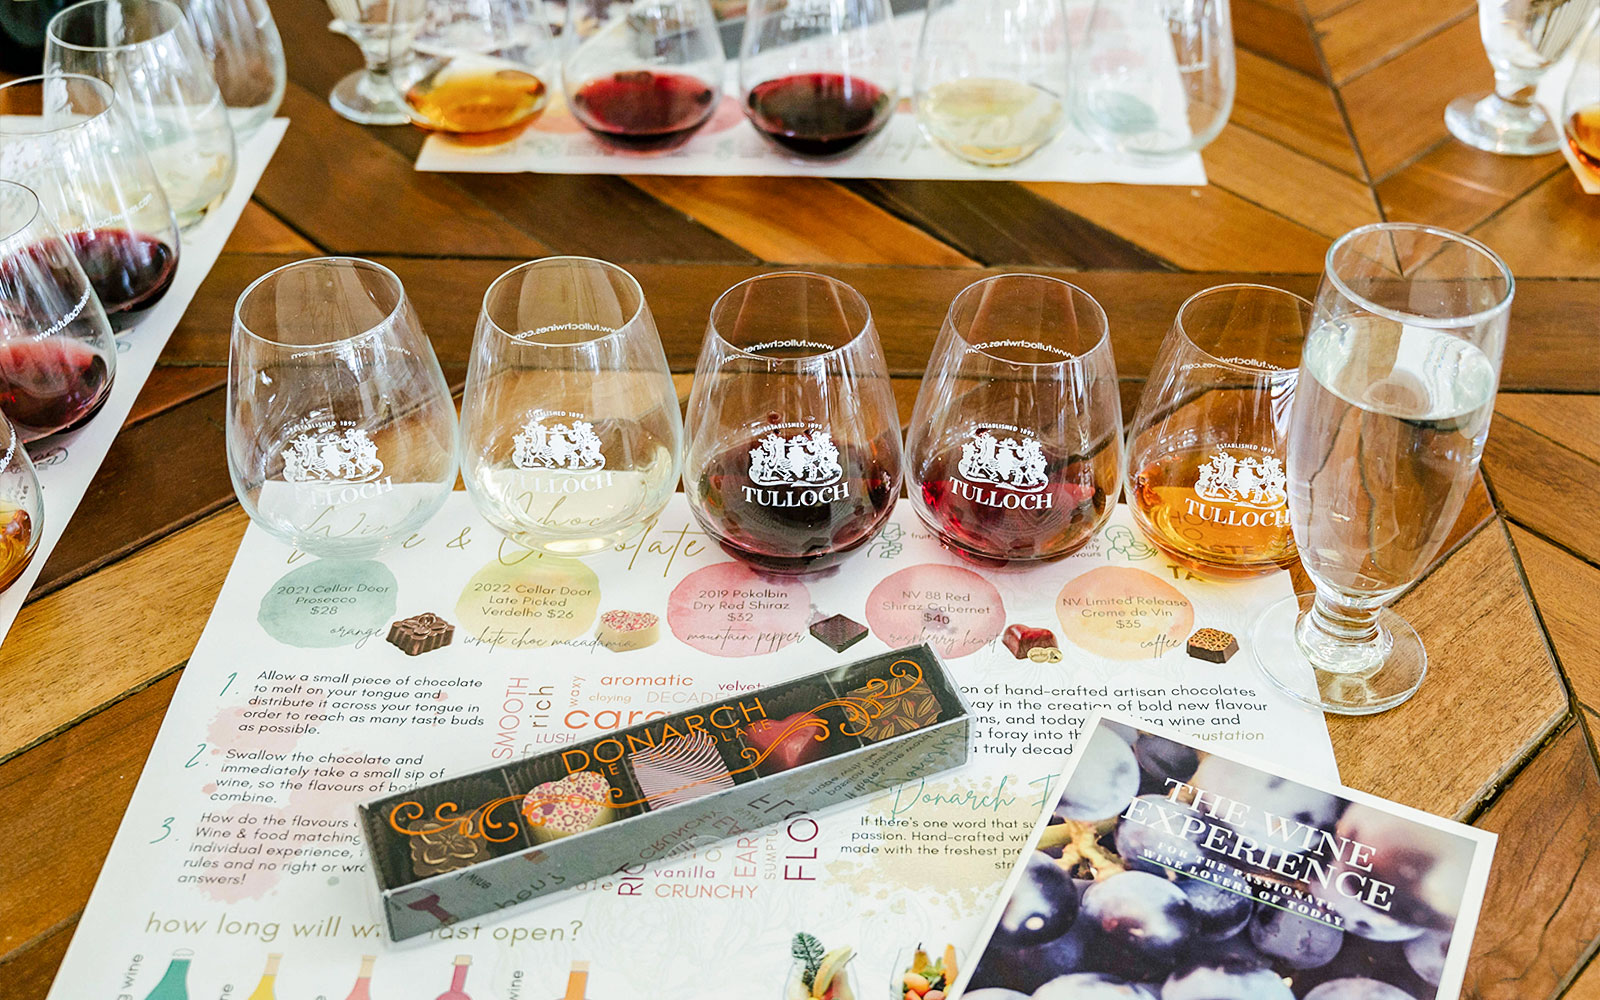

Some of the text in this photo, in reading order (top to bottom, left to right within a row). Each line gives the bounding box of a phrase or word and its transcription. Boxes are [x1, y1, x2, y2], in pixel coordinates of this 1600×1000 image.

[977, 422, 1018, 432] ESTABLISHED
[1216, 443, 1258, 451] ESTABLISHED
[741, 481, 850, 507] TULLOCH
[949, 476, 1053, 510] TULLOCH
[1184, 498, 1292, 528] TULLOCH
[446, 526, 471, 550] &
[276, 583, 392, 596] 2021 Cellar Door
[473, 583, 592, 597] 2022 Cellar Door
[699, 588, 788, 600] 2019 Pokolbin
[902, 591, 971, 602] NV 88 Red
[295, 595, 357, 605] Prosecco
[489, 596, 568, 608] Late Picked
[693, 600, 790, 613] Dry Red Shiraz
[1062, 597, 1188, 608] NV Limited Release
[310, 604, 339, 617] $28
[482, 607, 575, 621] Verdelho $26
[882, 601, 991, 615] Shiraz Cabernet
[1081, 607, 1173, 619] Creme de Vin
[727, 611, 754, 623] $32
[923, 612, 951, 626] $40
[1115, 618, 1142, 631] $35
[330, 625, 385, 650] orange
[463, 630, 512, 658] white
[513, 630, 547, 650] choc
[686, 627, 807, 652] mountain pepper
[1140, 632, 1184, 659] coffee
[256, 670, 297, 681] Allow
[313, 673, 350, 685] small
[352, 676, 392, 688] piece
[414, 675, 483, 688] chocolate
[600, 673, 694, 686] aromatic
[271, 684, 442, 702] melt your tongue and
[569, 675, 587, 706] waxy
[1005, 684, 1256, 697] hand-crafted artisan chocolates
[248, 697, 464, 715] distribute across your tongue
[588, 693, 632, 705] cloying
[1017, 699, 1269, 711] the bold new flavour
[529, 685, 554, 728] rich
[243, 709, 486, 727] order reach many taste buds
[492, 677, 530, 760] SMOOTH
[1006, 714, 1241, 729] and today wine and
[258, 722, 321, 735] possible.
[988, 727, 1063, 742] foray into
[535, 732, 577, 745] LUSH
[561, 696, 768, 776] DONARCH
[983, 743, 1018, 757] truly
[225, 749, 288, 761] Swallow
[291, 750, 314, 763] the
[318, 752, 392, 765] chocolate
[395, 754, 425, 766] and
[220, 763, 426, 782] immediately take small sip
[215, 779, 366, 793] wine, the flavours
[209, 791, 278, 805] combine.
[889, 775, 1016, 821] Donarch
[200, 812, 235, 825] How
[262, 814, 287, 826] the
[291, 814, 350, 829] flavours
[860, 816, 871, 826] If
[874, 816, 919, 828] there's
[922, 819, 948, 829] one
[951, 818, 988, 828] word
[991, 818, 1018, 828] that
[1163, 776, 1378, 873] THE WINE
[195, 827, 233, 839] Wine
[236, 827, 247, 839] &
[252, 828, 290, 841] food
[851, 831, 1004, 842] passion. Hand-crafted
[188, 842, 354, 860] individual experience,
[840, 843, 998, 856] made with the freshest
[1119, 795, 1397, 913] EXPERIENCE
[183, 857, 317, 874] rules and right
[654, 865, 716, 878] vanilla
[176, 873, 247, 886] answers!
[1156, 841, 1338, 913] FOR THE PASSIONATE
[654, 883, 759, 898] CRUNCHY
[1142, 848, 1346, 928] WINE LOVERS OF TODAY
[144, 911, 207, 934] how
[216, 914, 281, 943] long
[292, 915, 342, 938] will
[492, 919, 584, 947] open?
[120, 953, 145, 989] wine
